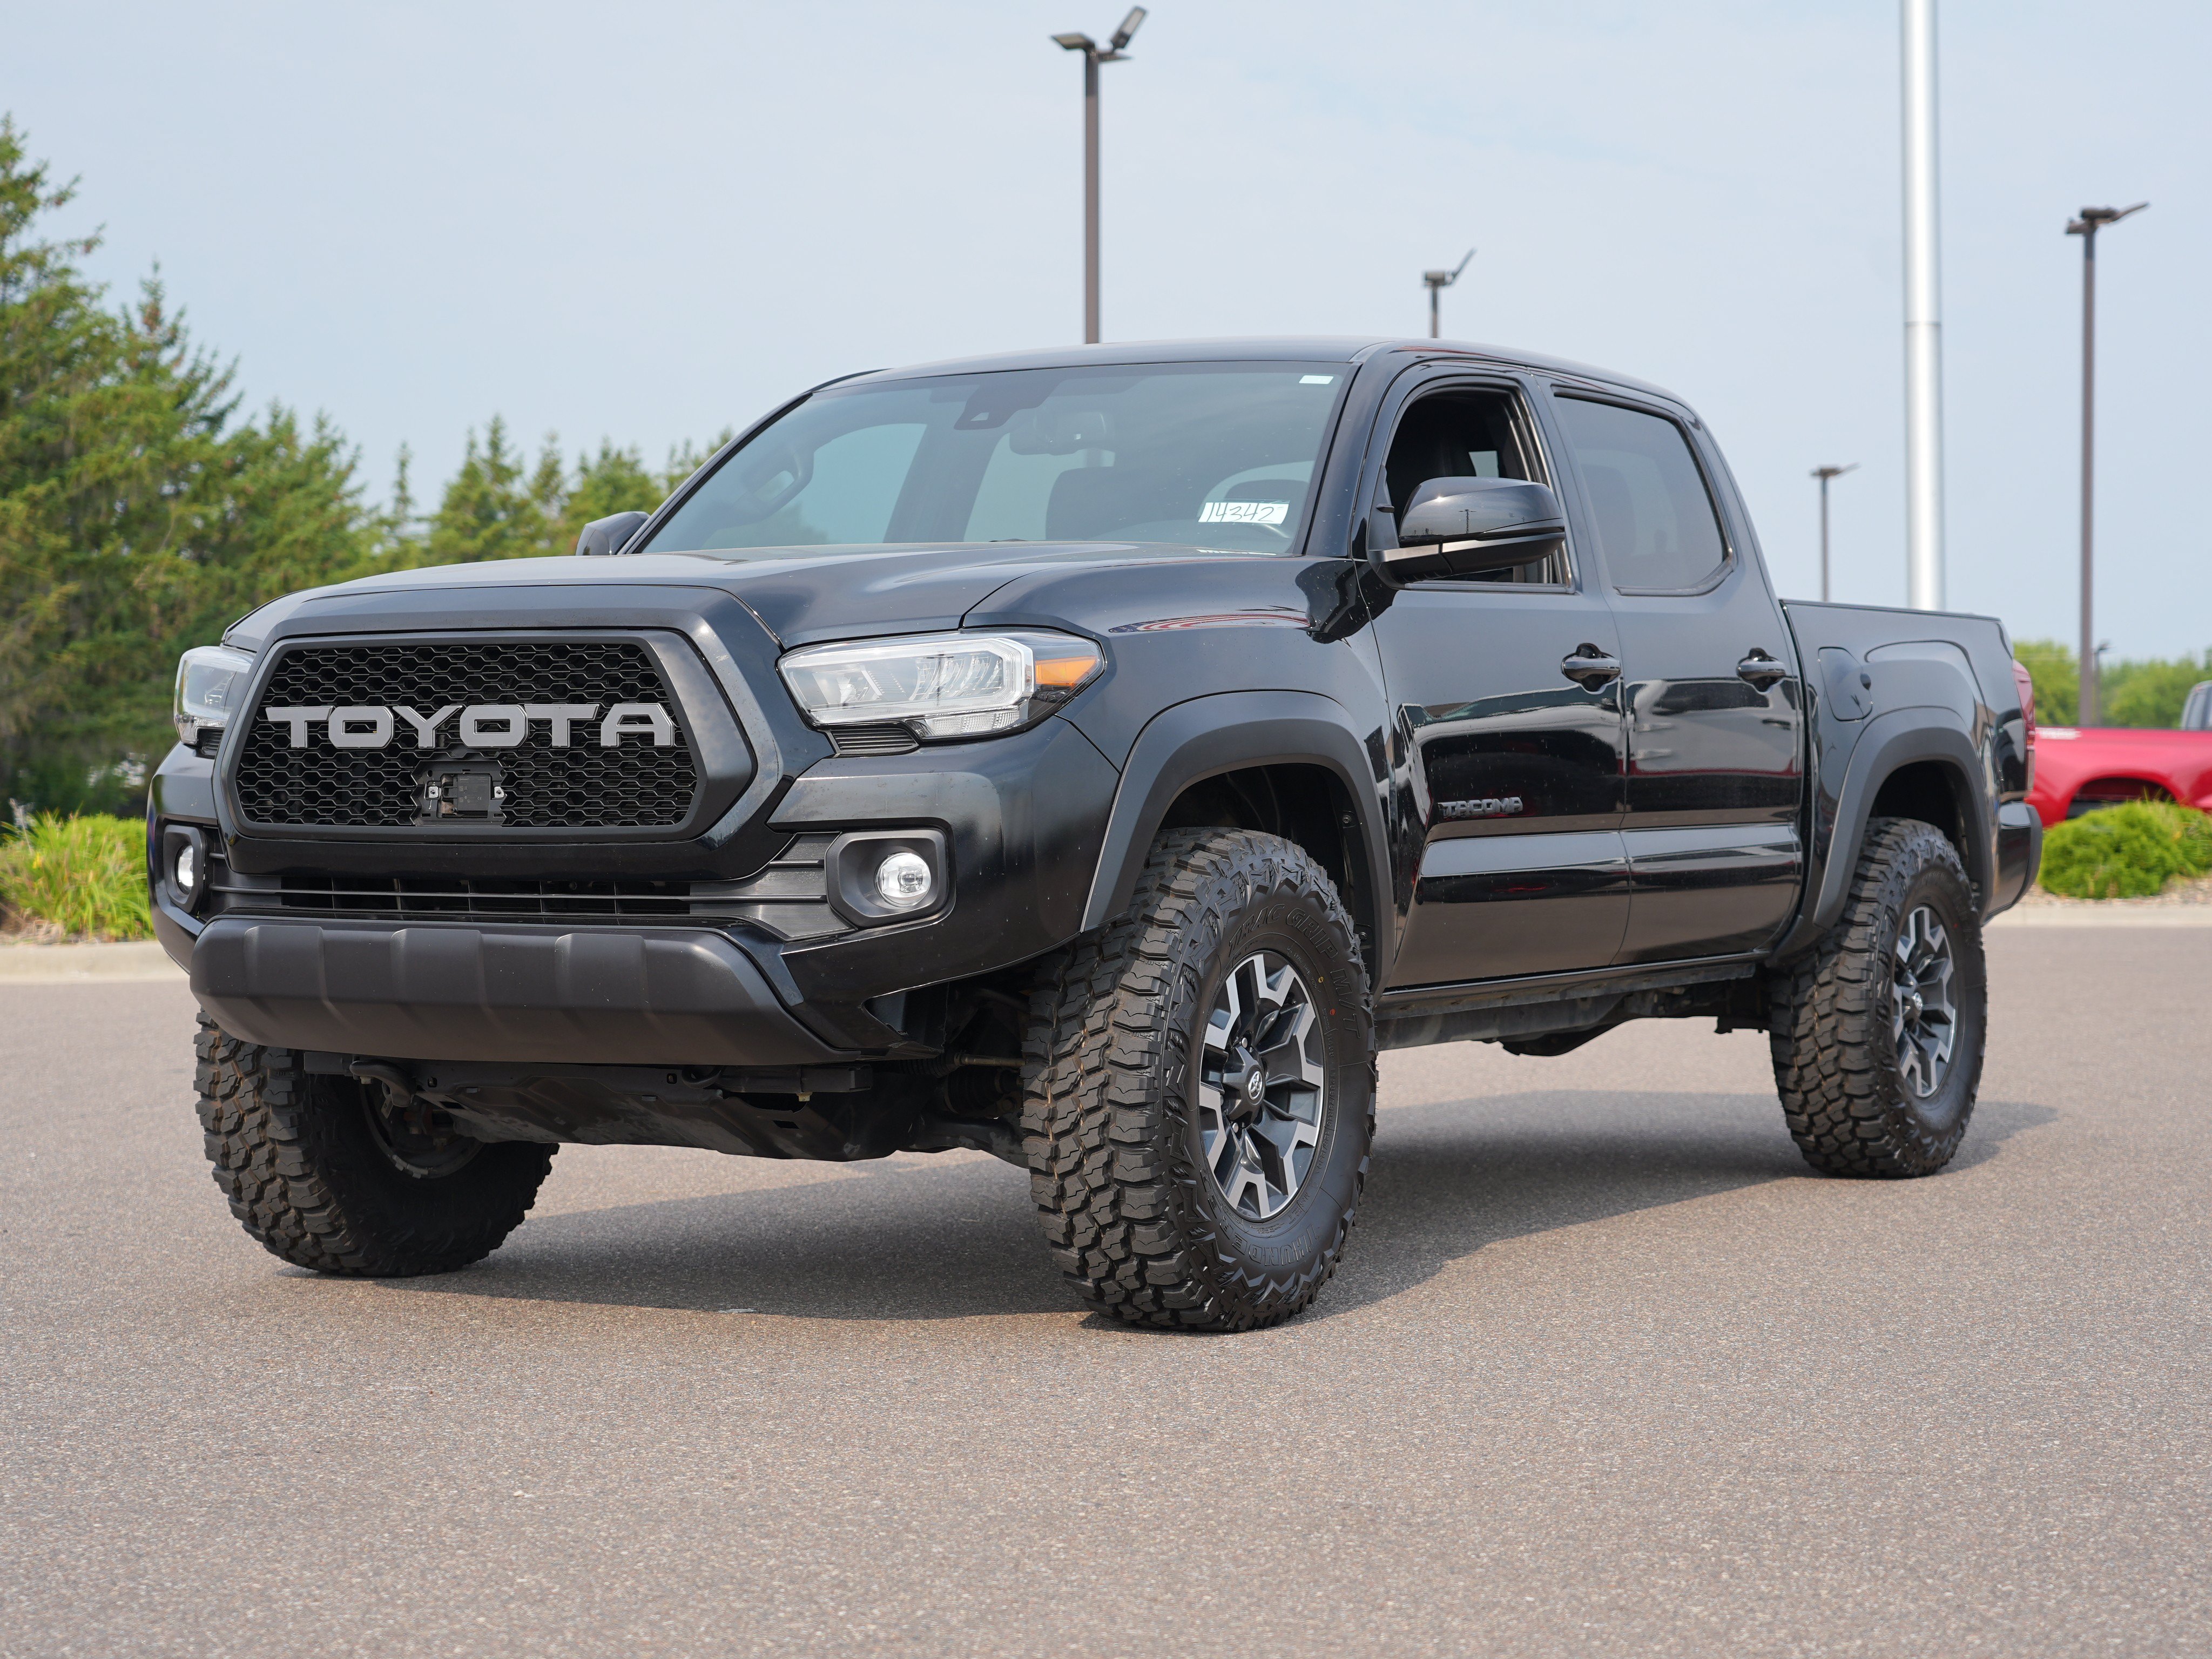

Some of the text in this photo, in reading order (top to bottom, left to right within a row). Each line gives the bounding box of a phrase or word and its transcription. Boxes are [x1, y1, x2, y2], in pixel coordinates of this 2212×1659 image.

[1206, 502, 1274, 522] 14342
[265, 703, 674, 748] TOYOTA
[1438, 797, 1523, 818] TACOMA
[1228, 903, 1285, 958] TRAC
[1286, 908, 1338, 959] GRIP
[1330, 968, 1360, 1038] M/T
[1199, 1168, 1321, 1267] THUNDERER
